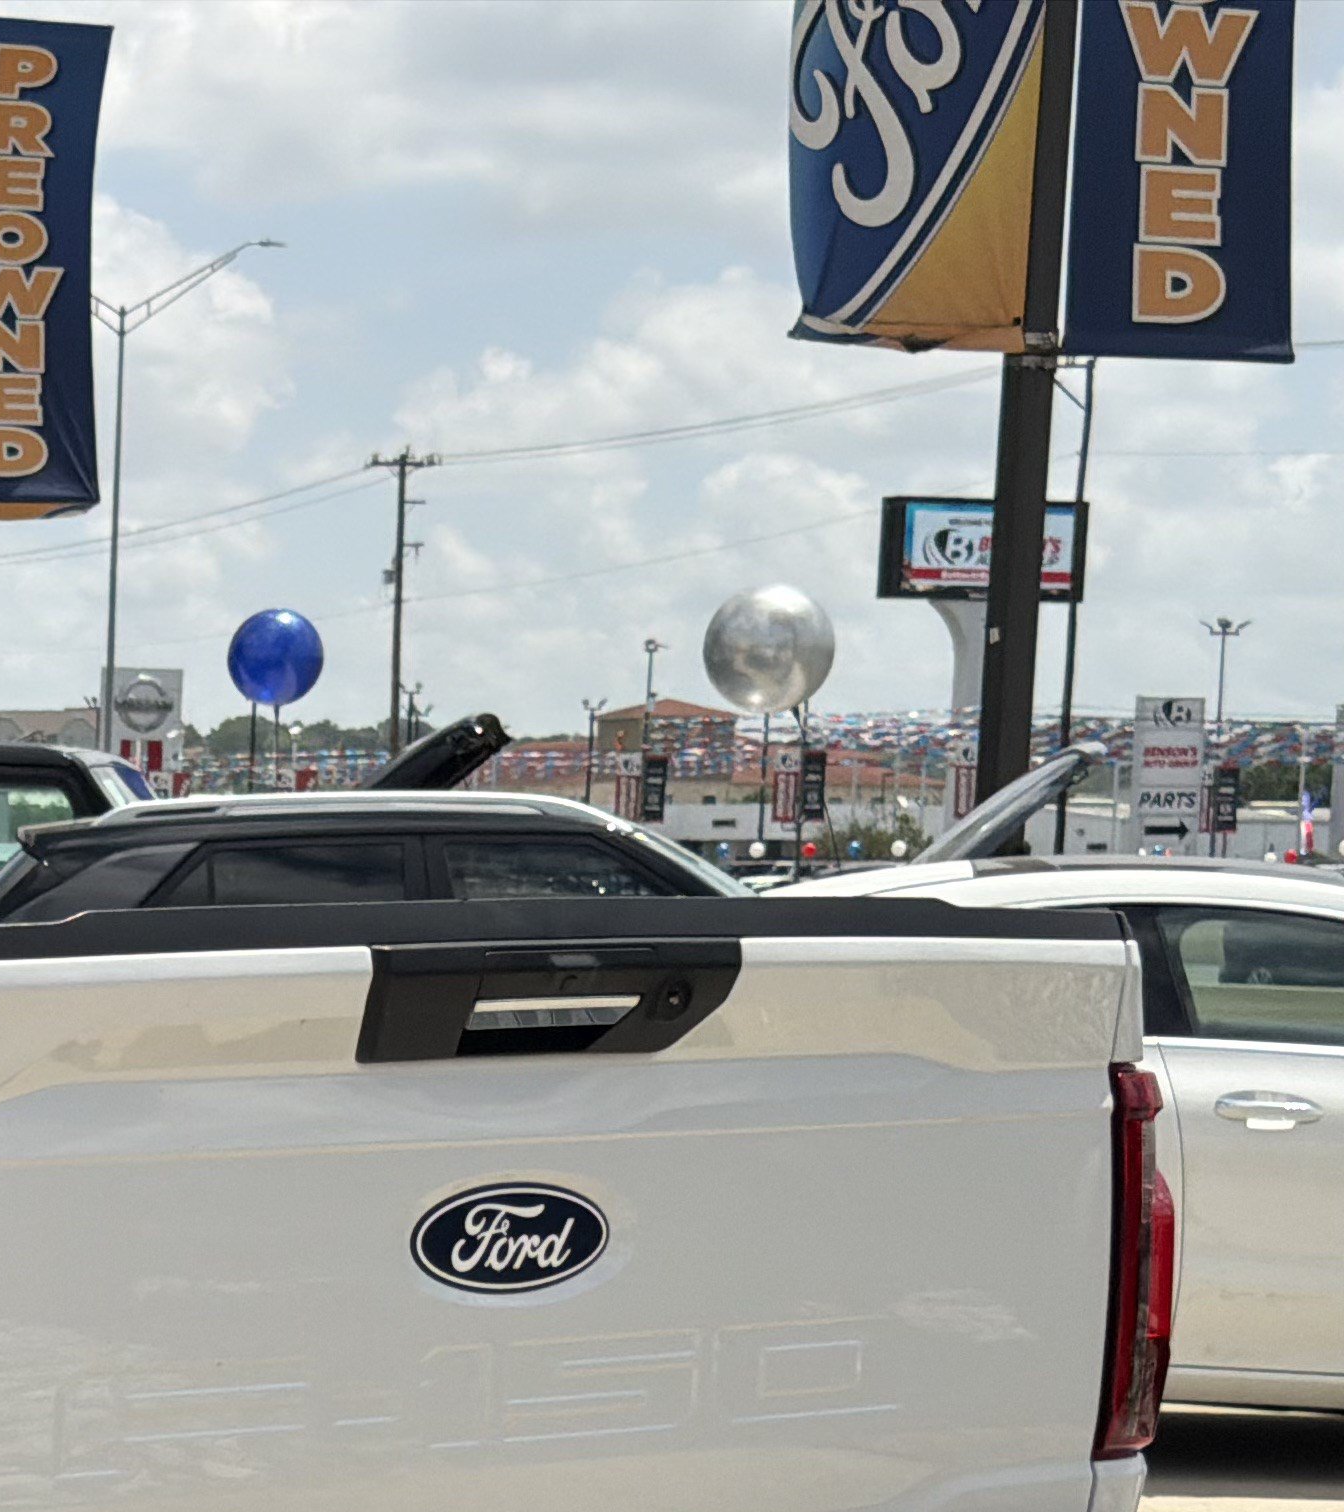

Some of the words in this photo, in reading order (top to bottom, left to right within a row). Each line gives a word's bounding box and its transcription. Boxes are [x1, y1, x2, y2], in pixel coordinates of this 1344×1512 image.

[791, 0, 983, 228] Fo
[1122, 0, 1259, 325] WNED
[1138, 791, 1197, 809] PARTS
[450, 1203, 576, 1273] Ford
